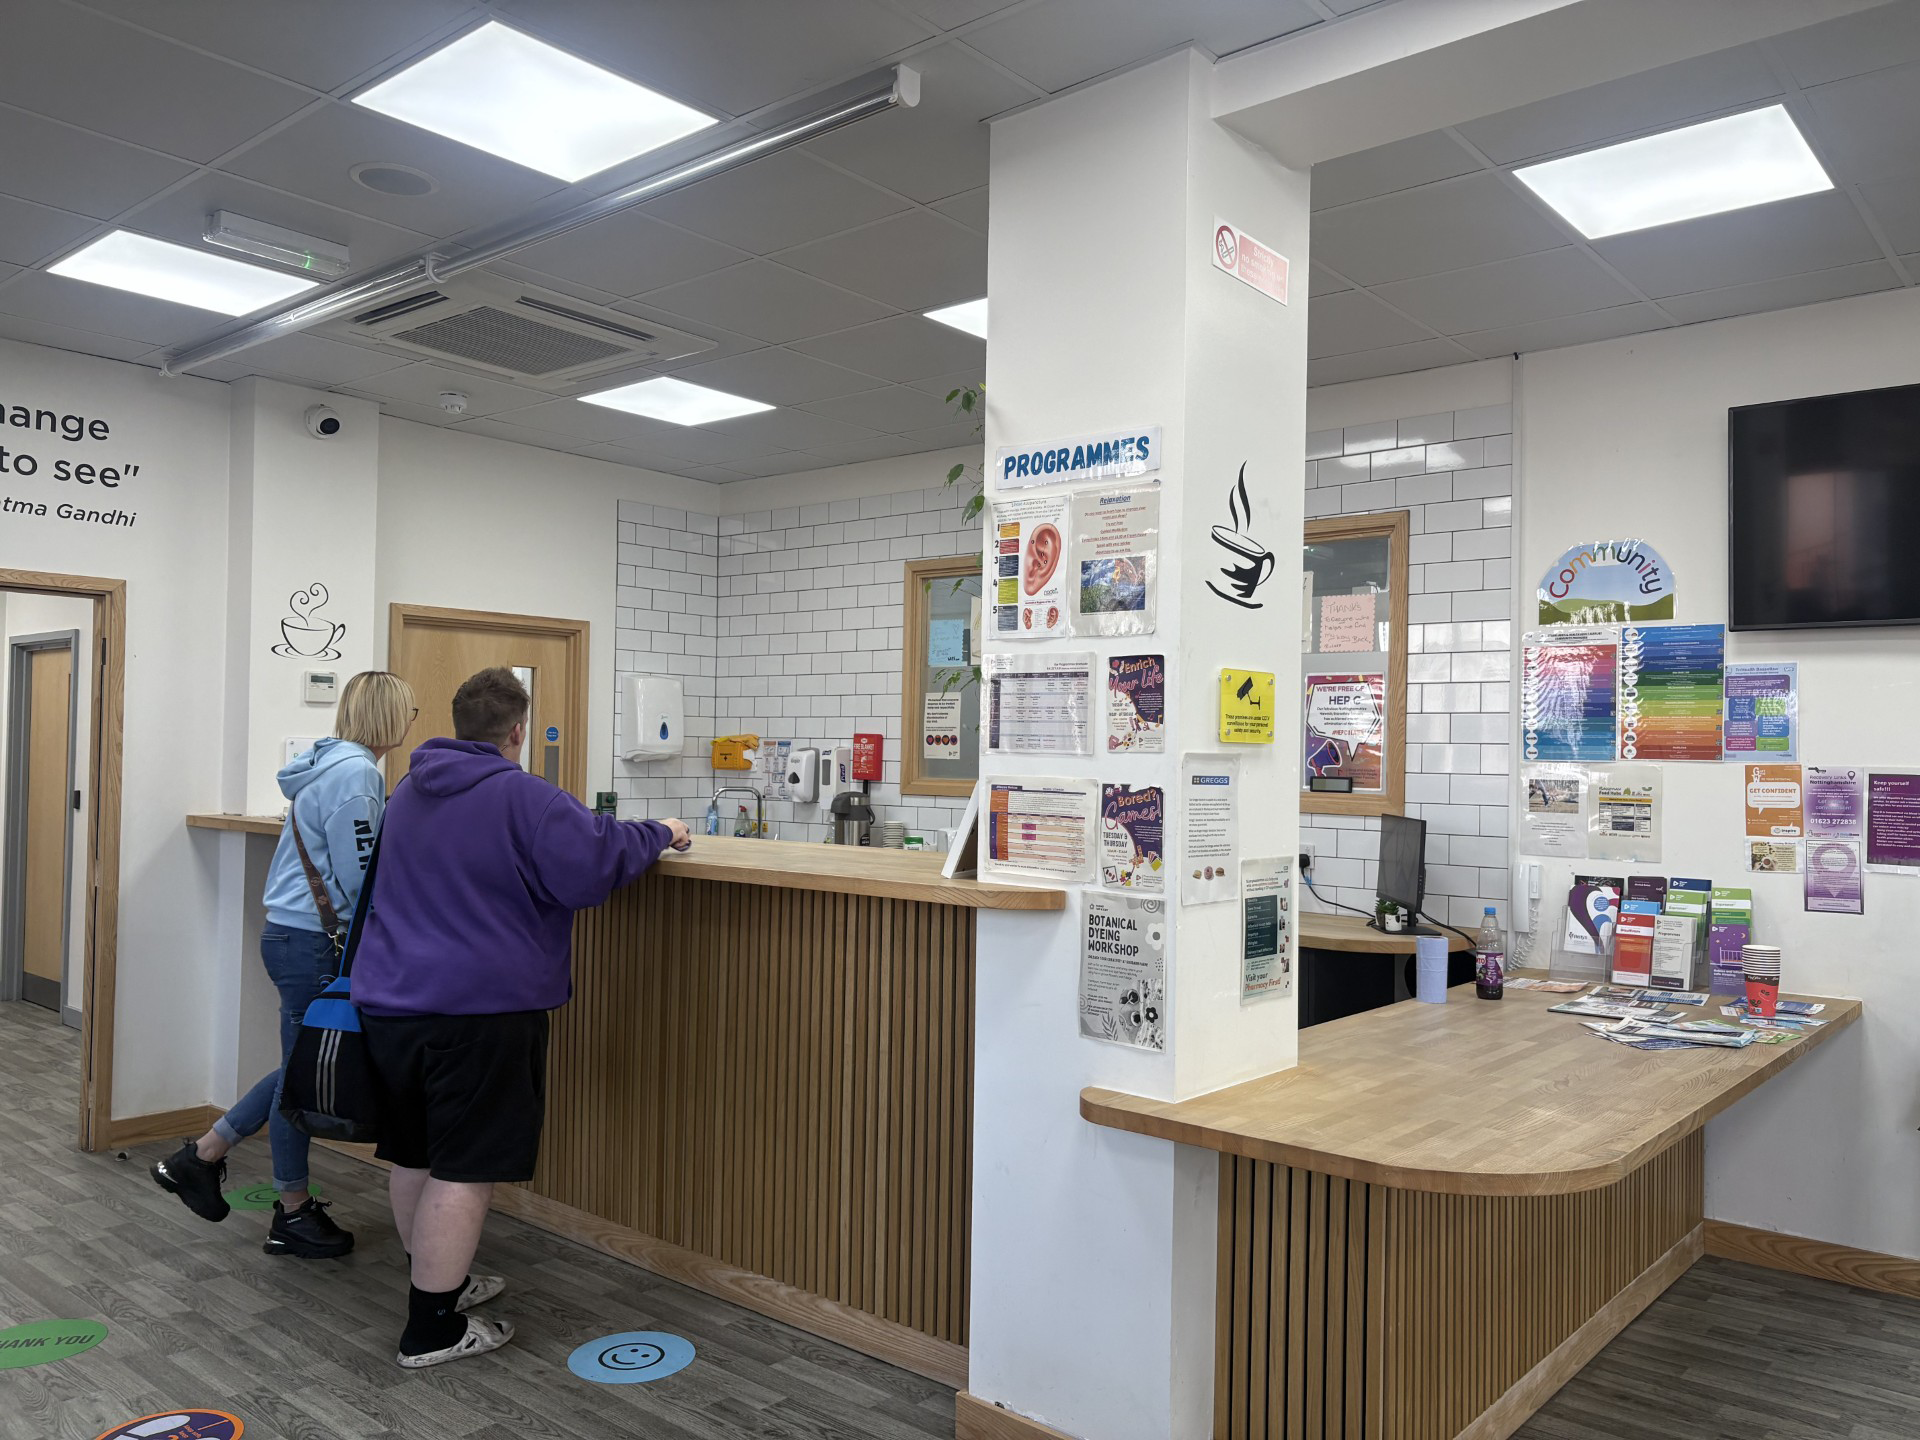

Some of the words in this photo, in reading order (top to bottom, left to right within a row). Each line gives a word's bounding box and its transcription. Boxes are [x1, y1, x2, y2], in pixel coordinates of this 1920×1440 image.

[1241, 254, 1250, 263] no
[0, 403, 110, 441] ange
[1003, 436, 1150, 480] PROGRAMMES
[0, 446, 38, 475] to
[53, 459, 140, 488] see"
[1099, 495, 1132, 506] Relaxation
[0, 496, 48, 517] tma
[56, 503, 137, 527] Gandhi
[994, 540, 999, 549] 2
[993, 556, 999, 565] 3
[1549, 545, 1663, 599] Community
[992, 579, 998, 587] 4
[992, 605, 998, 614] 5
[1124, 656, 1156, 675] Enrich
[1108, 675, 1139, 699] Your
[1140, 664, 1164, 689] Life
[1329, 695, 1351, 705] HEP
[1353, 695, 1361, 705] C
[1200, 776, 1229, 785] GREGGS
[1117, 788, 1157, 807] Bored?
[1104, 794, 1163, 830] Games!
[1103, 831, 1123, 840] TUESDAY
[1103, 839, 1128, 848] THURSDAY
[1088, 913, 1138, 931] BOTANICAL
[1088, 926, 1120, 942] DYEING
[1087, 939, 1139, 957] WORKSHOP
[1245, 972, 1257, 982] Visit
[1256, 972, 1269, 983] your
[1244, 981, 1268, 992] Pharmacy
[54, 1334, 96, 1346] YOU
